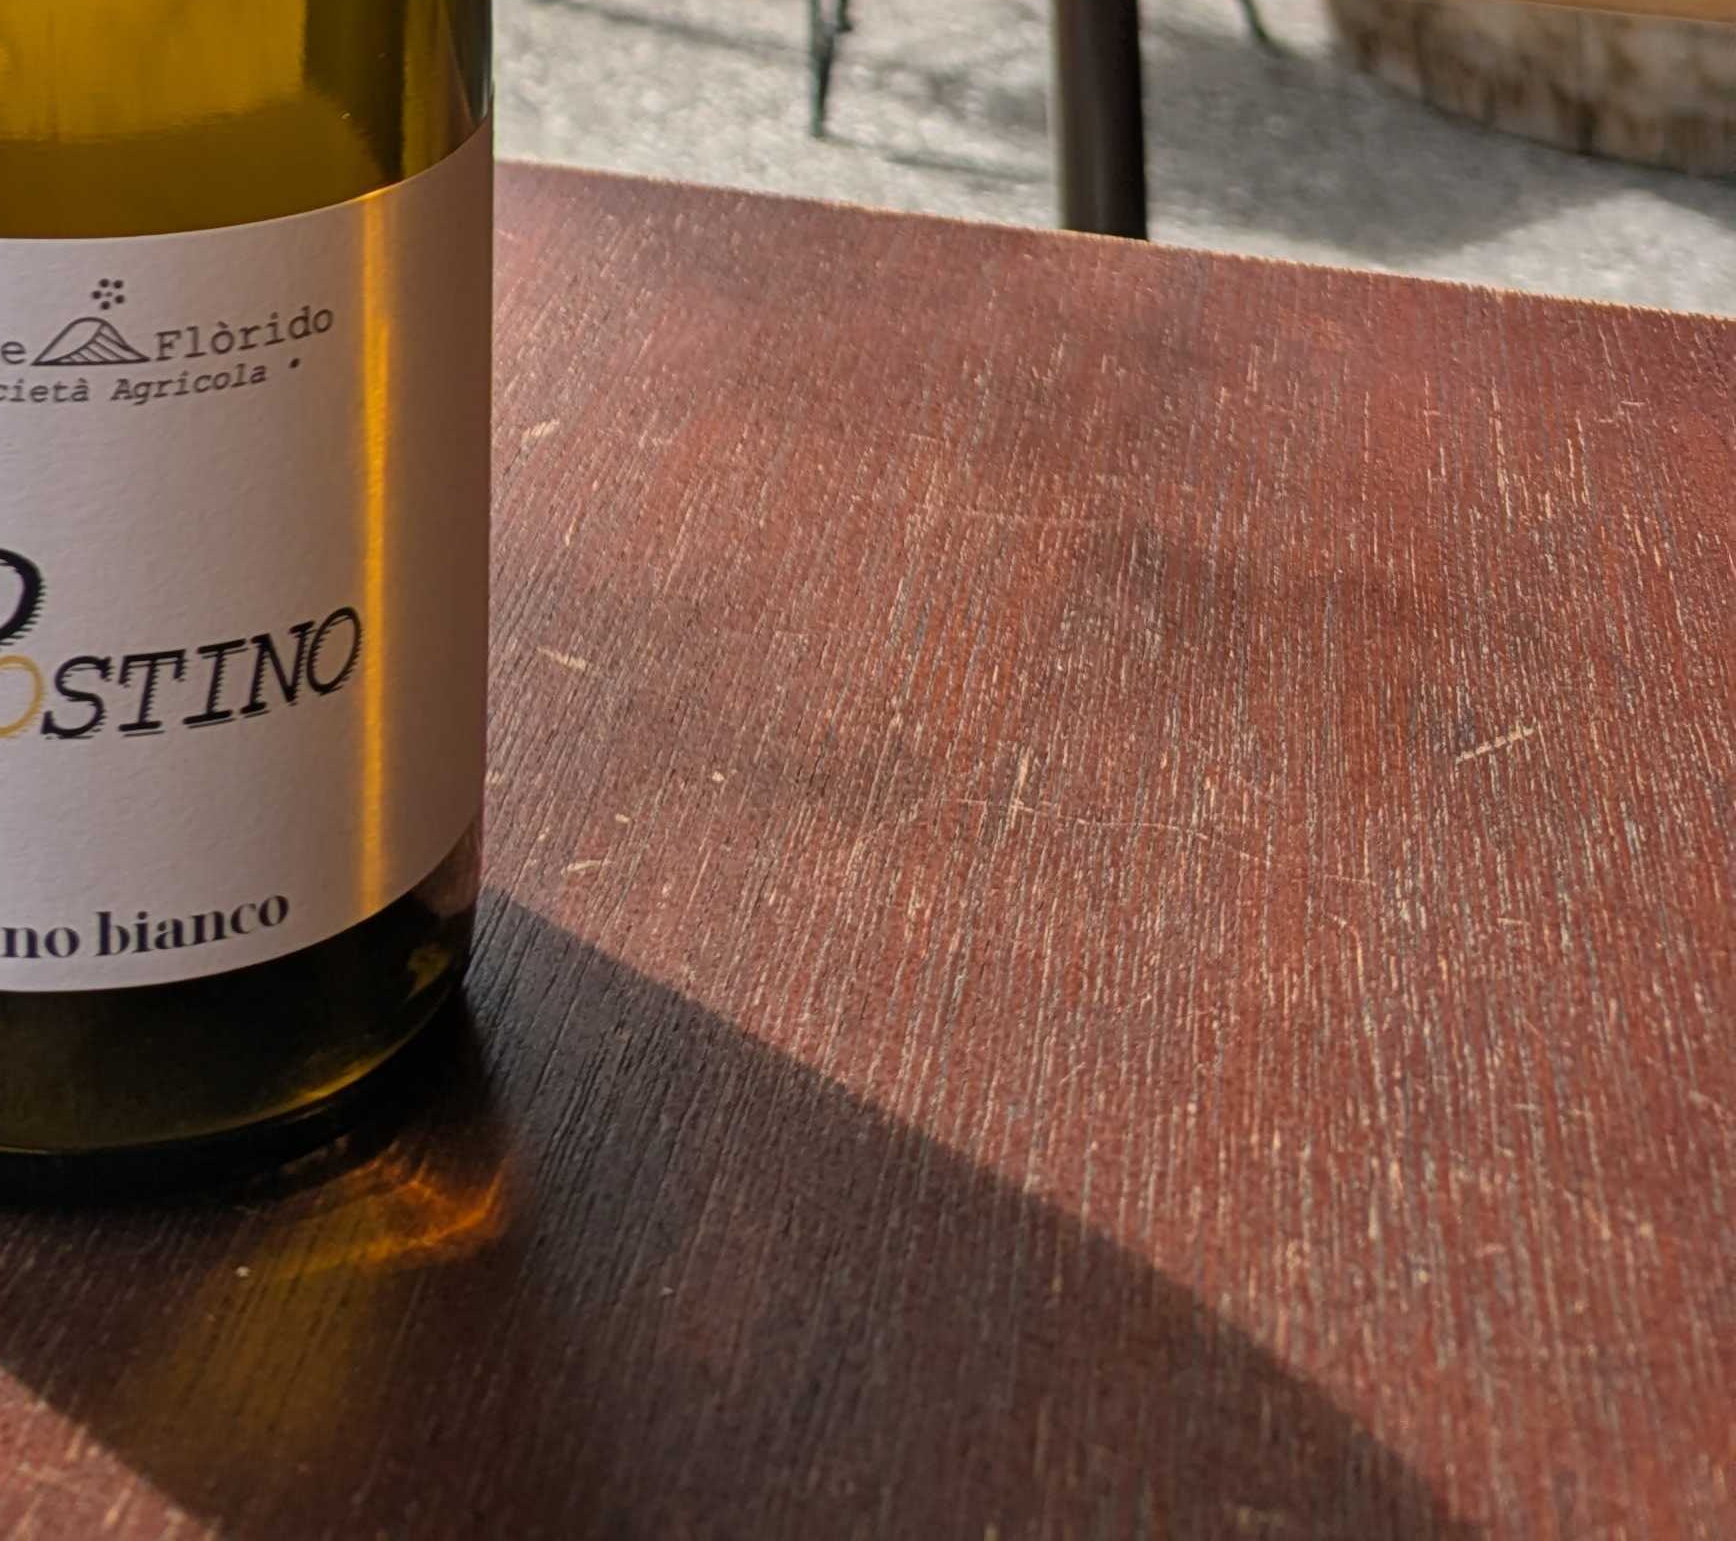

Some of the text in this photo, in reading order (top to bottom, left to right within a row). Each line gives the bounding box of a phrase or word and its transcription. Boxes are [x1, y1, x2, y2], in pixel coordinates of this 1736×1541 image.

[155, 305, 335, 362] Flòrido
[110, 363, 268, 406] Agricola
[95, 894, 290, 957] bianco
